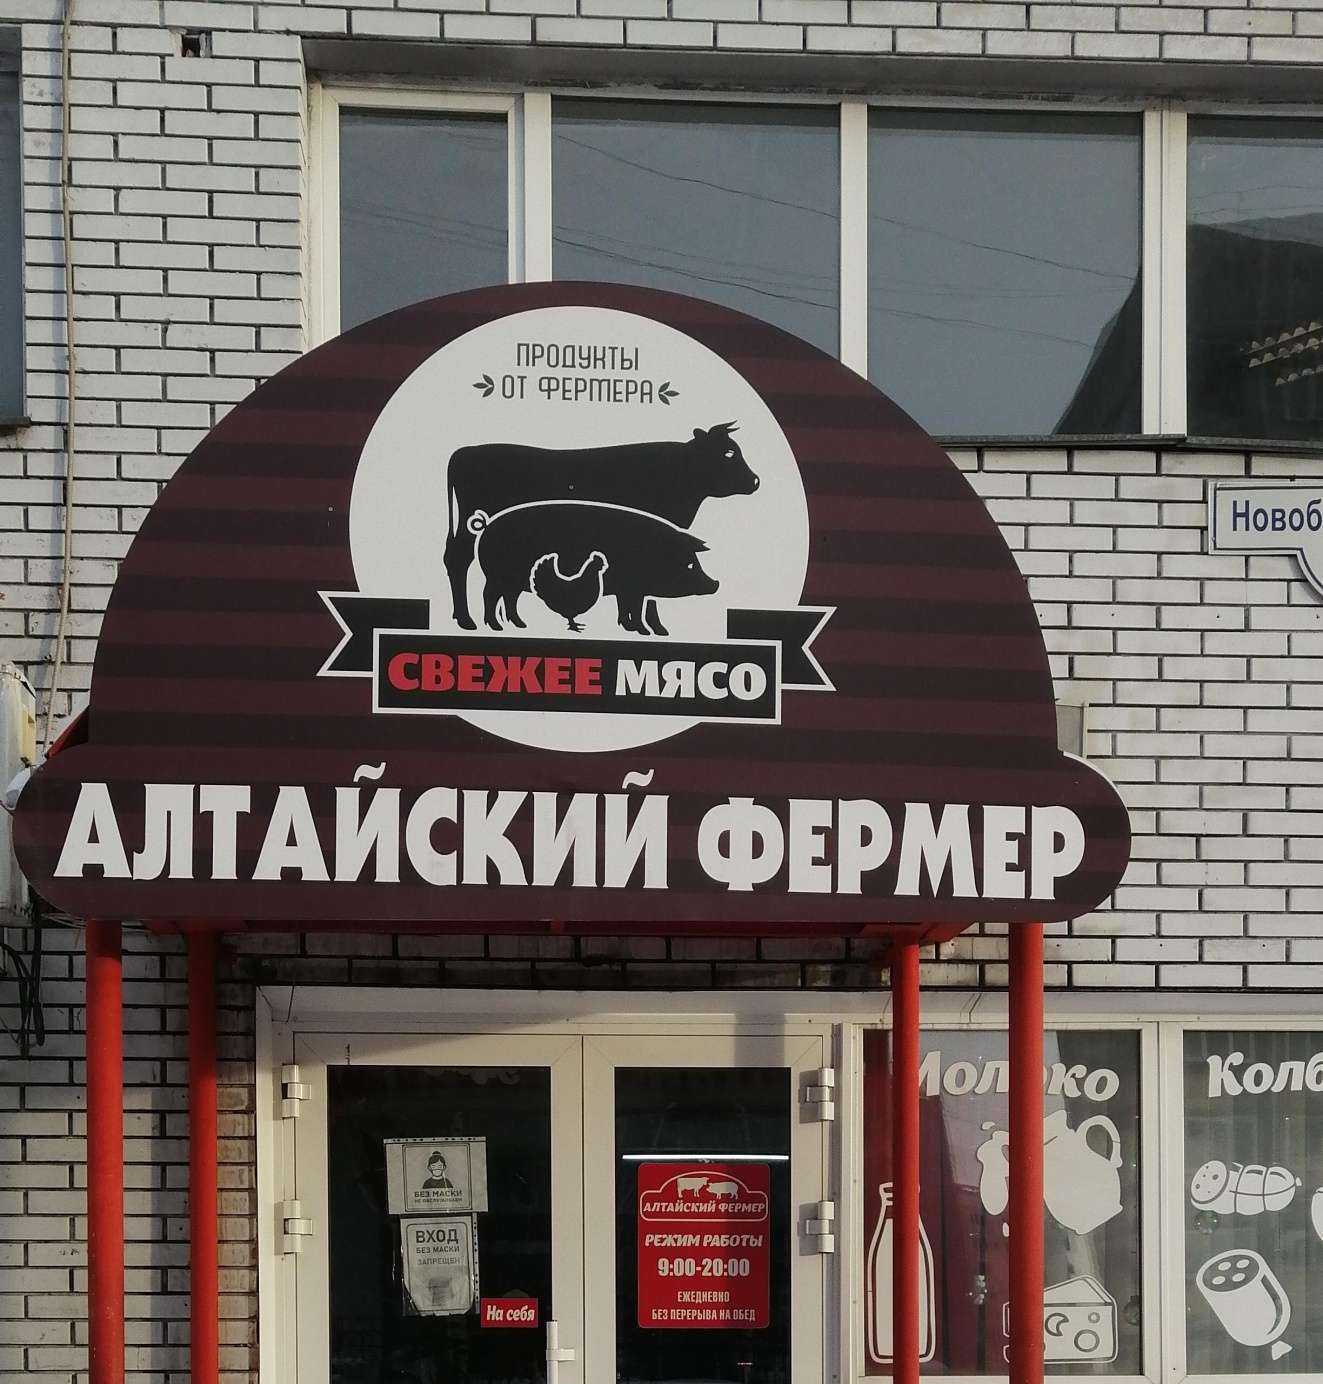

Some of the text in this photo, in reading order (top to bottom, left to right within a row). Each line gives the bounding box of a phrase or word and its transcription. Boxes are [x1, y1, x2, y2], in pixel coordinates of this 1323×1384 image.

[515, 342, 640, 372] ПРОДУКТЫ
[501, 375, 654, 404] ОТ ФЕРМЕРА
[1232, 498, 1323, 532] Новоб
[387, 652, 768, 701] СВЕЖЕЕ МЯСО
[54, 761, 1086, 901] АЛТАЙСКИЙ ФЕРМЕР
[918, 1050, 1120, 1102] олко
[414, 1189, 463, 1198] БЕЗ МАСКИ
[643, 1200, 766, 1213] АЛТАЙСКИЙ ФЕРМЕР
[415, 1229, 459, 1245] ВХОД
[645, 1234, 763, 1247] РЕЖИМ РАБОТЫ
[416, 1245, 460, 1254] БЕЗ МАСКИ
[657, 1258, 751, 1277] 9:00-20:00
[677, 1291, 730, 1304] ЕЖЕДНЕВНО
[486, 1305, 535, 1321] На себя
[652, 1309, 756, 1322] БЕЗ ПЕРЕРЫВА НА ОБЕД
